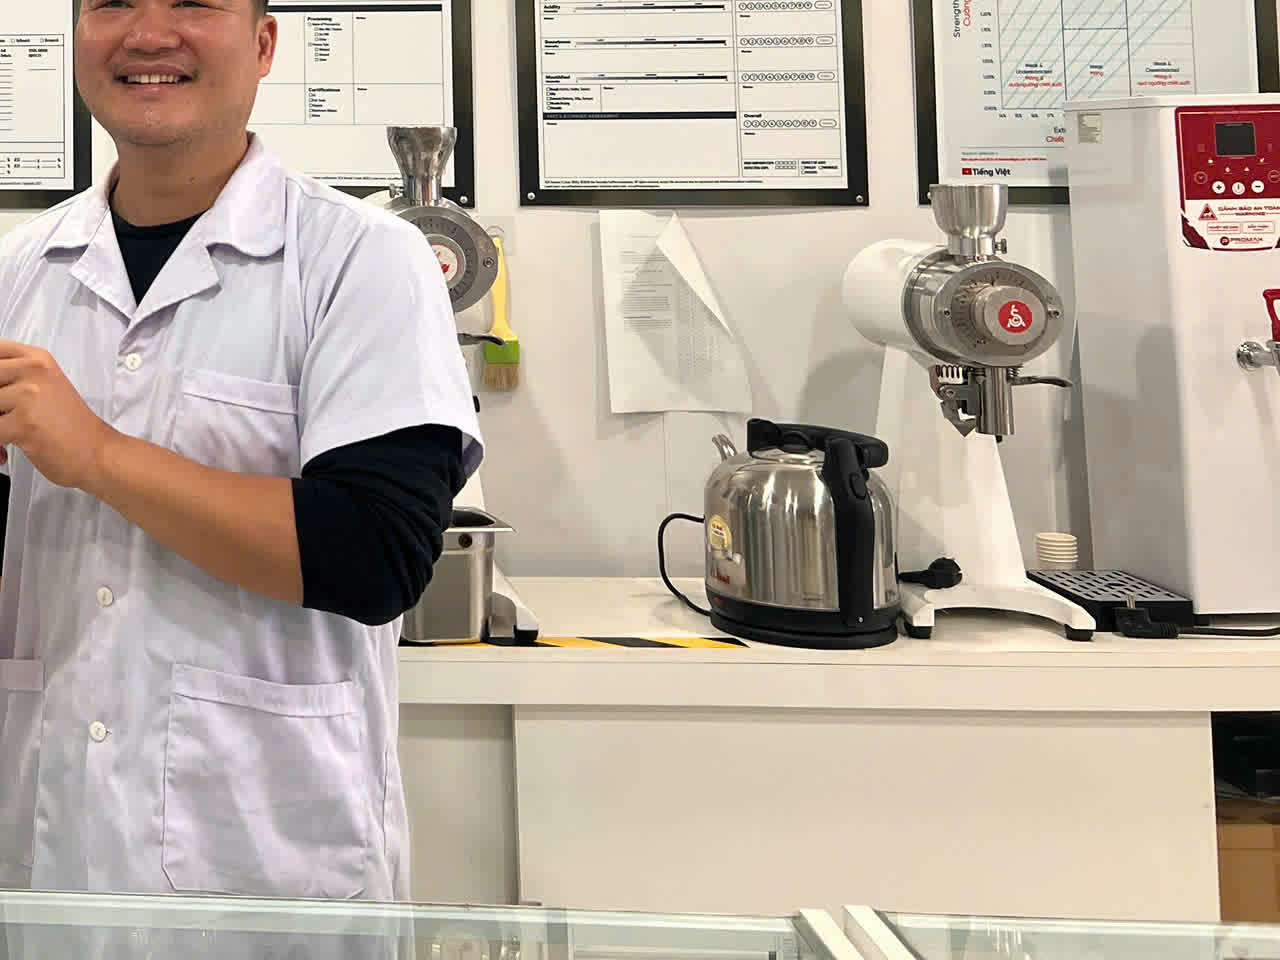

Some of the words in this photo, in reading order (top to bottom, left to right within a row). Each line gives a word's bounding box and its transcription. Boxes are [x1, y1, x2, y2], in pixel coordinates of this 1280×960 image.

[953, 0, 961, 38] Strength
[972, 167, 994, 177] Tiếng
[995, 167, 1011, 176] Việt
